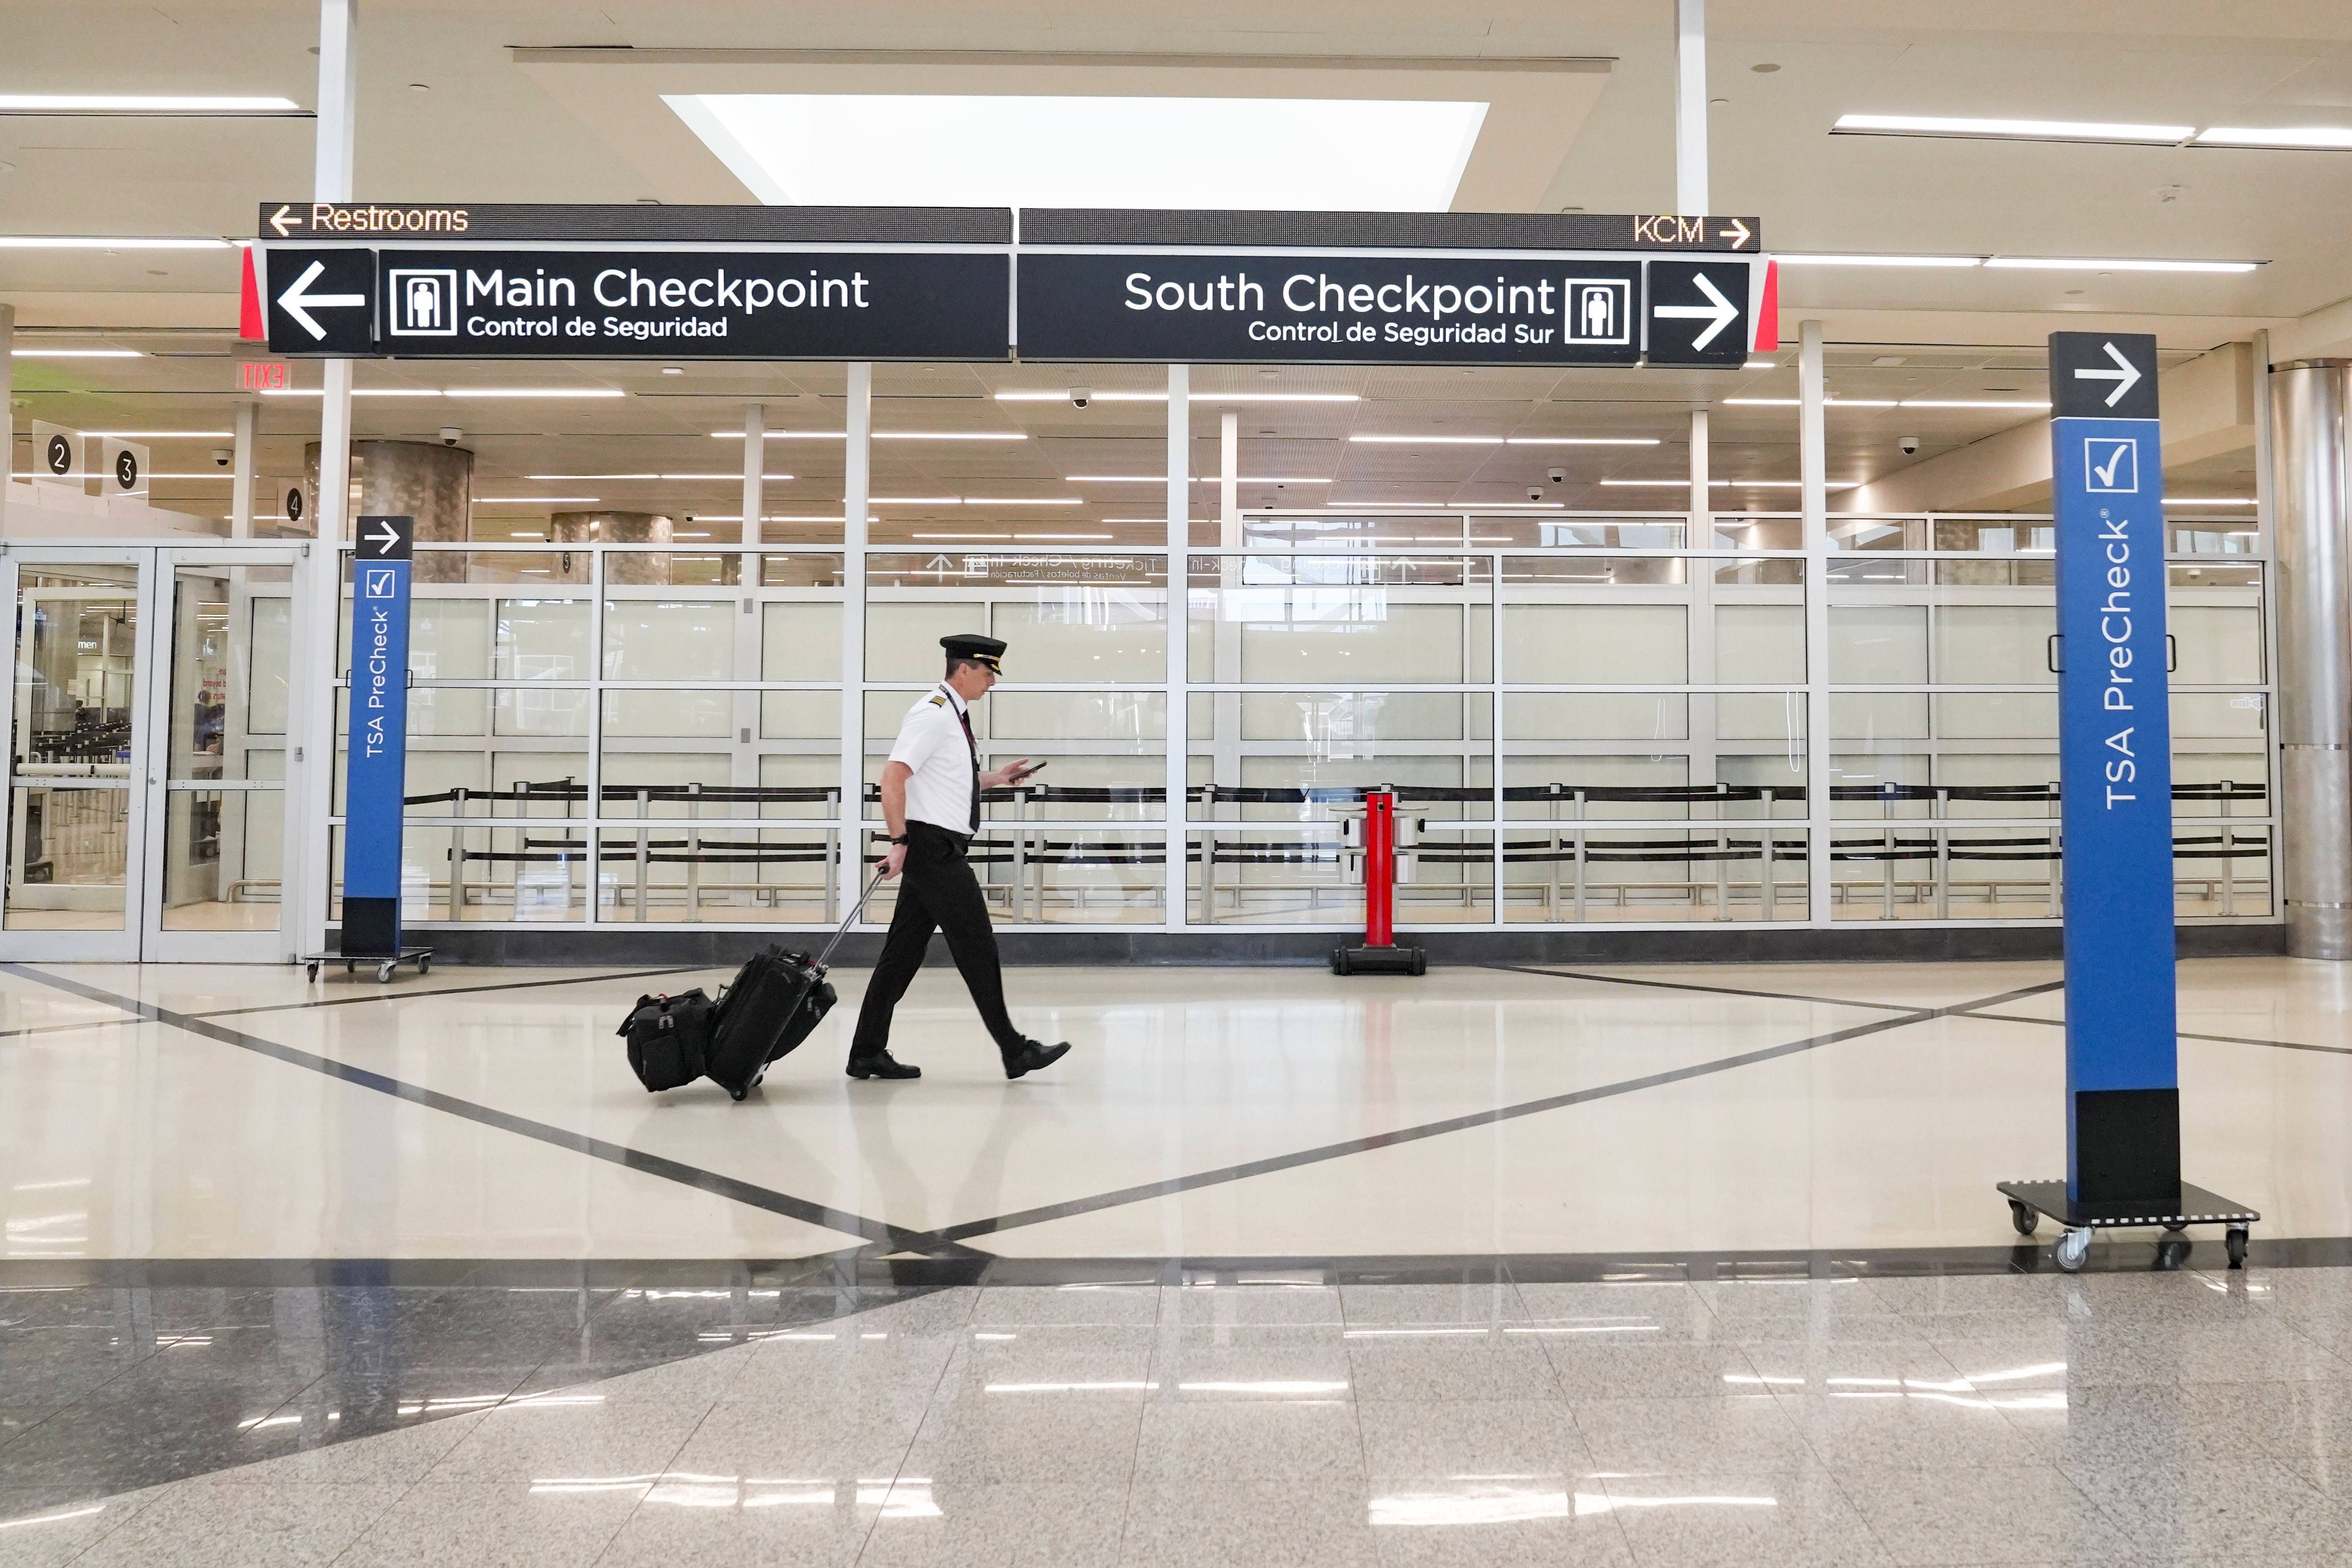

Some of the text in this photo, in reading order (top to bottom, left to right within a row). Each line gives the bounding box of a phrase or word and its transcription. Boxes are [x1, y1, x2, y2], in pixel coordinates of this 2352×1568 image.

[312, 204, 468, 231] Restrooms
[1635, 215, 1703, 242] KCM
[466, 269, 869, 314] Main Checkpoint
[1125, 273, 1555, 320] South Checkpoint
[467, 316, 727, 340] Control de Seguridad
[1249, 321, 1554, 346] Control de Seguridad Sur
[54, 443, 65, 468] 2
[122, 458, 132, 481] 3
[291, 495, 298, 515] 4
[565, 555, 569, 568] 5
[367, 716, 384, 758] TSA
[2105, 727, 2135, 810] TSA
